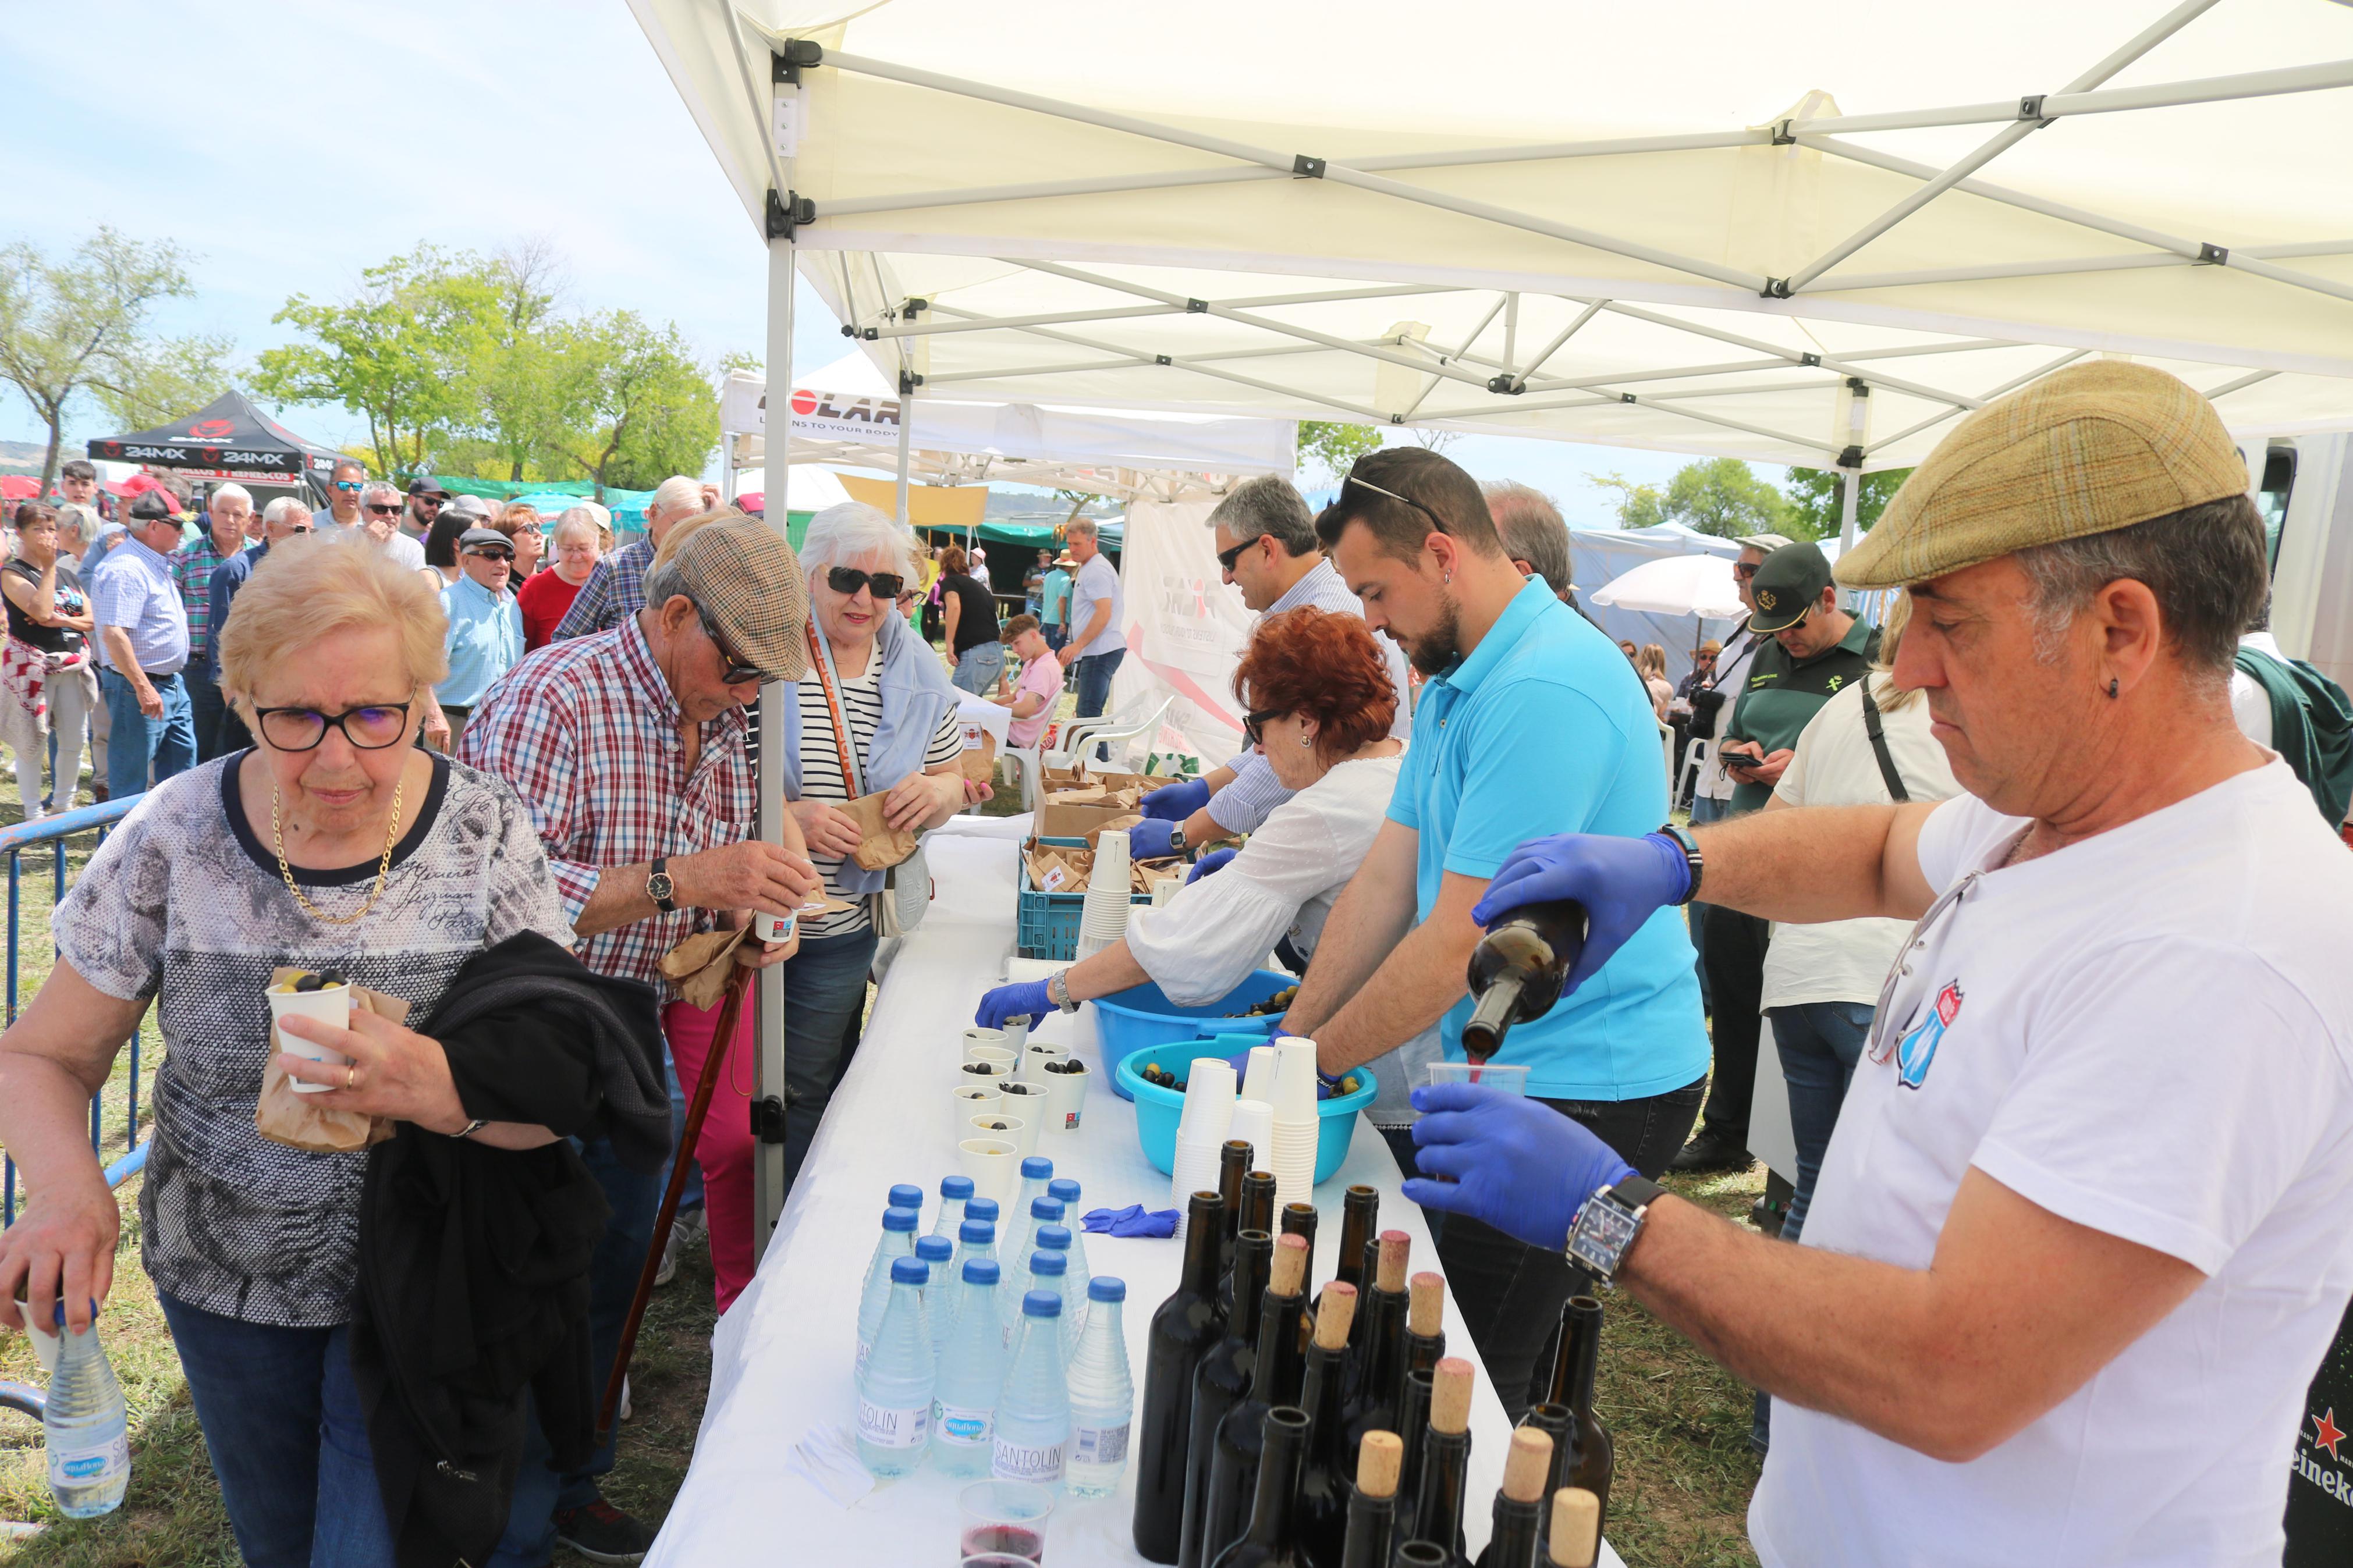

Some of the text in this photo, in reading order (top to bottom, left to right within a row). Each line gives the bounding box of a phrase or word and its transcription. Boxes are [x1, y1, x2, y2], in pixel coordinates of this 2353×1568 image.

[757, 388, 902, 425] OLAR
[829, 424, 862, 433] YOUR
[866, 428, 899, 436] BODY
[125, 446, 187, 460] 24MX
[223, 451, 285, 465] 24MX
